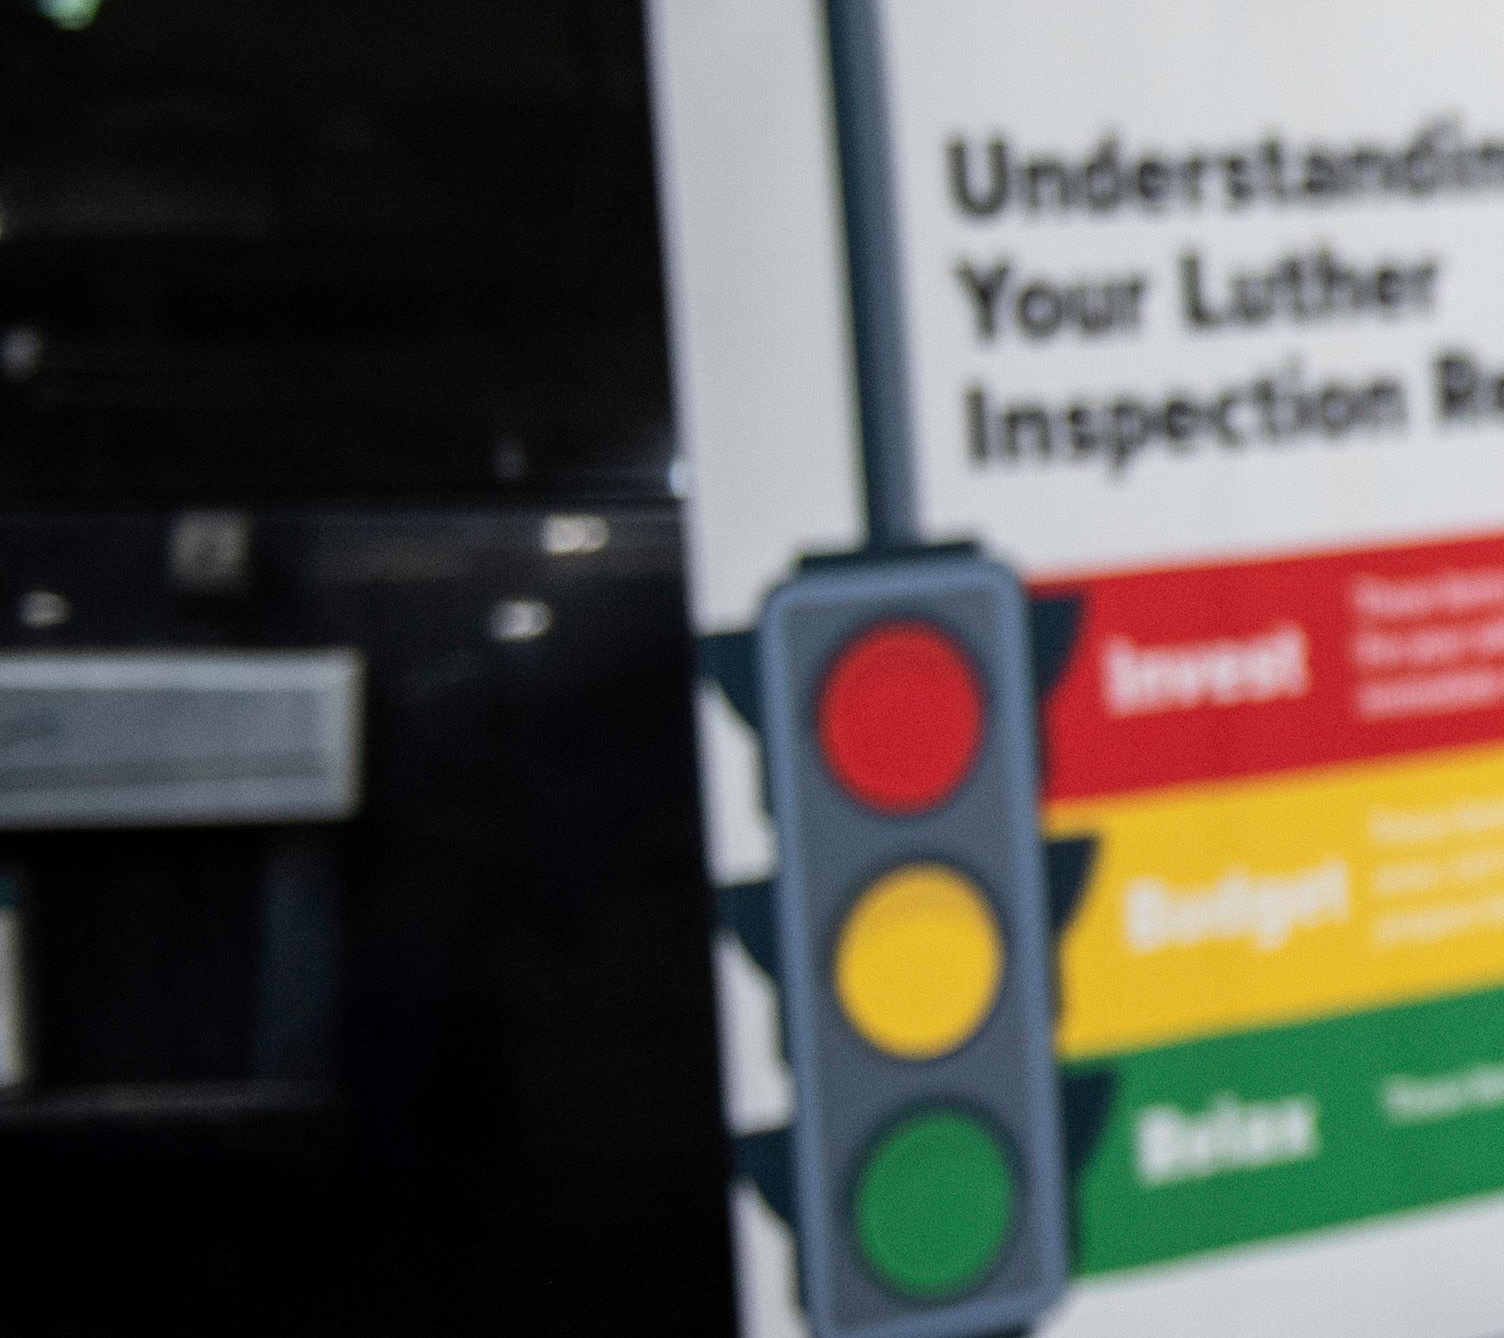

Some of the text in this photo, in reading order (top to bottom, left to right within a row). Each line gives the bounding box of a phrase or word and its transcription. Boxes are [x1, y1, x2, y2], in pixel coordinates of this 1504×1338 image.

[953, 244, 1443, 344] Your Luther
[963, 361, 1408, 479] Inspection
[1100, 621, 1310, 717] Invest
[1120, 856, 1353, 955] Budget
[1133, 1093, 1322, 1189] Relax
